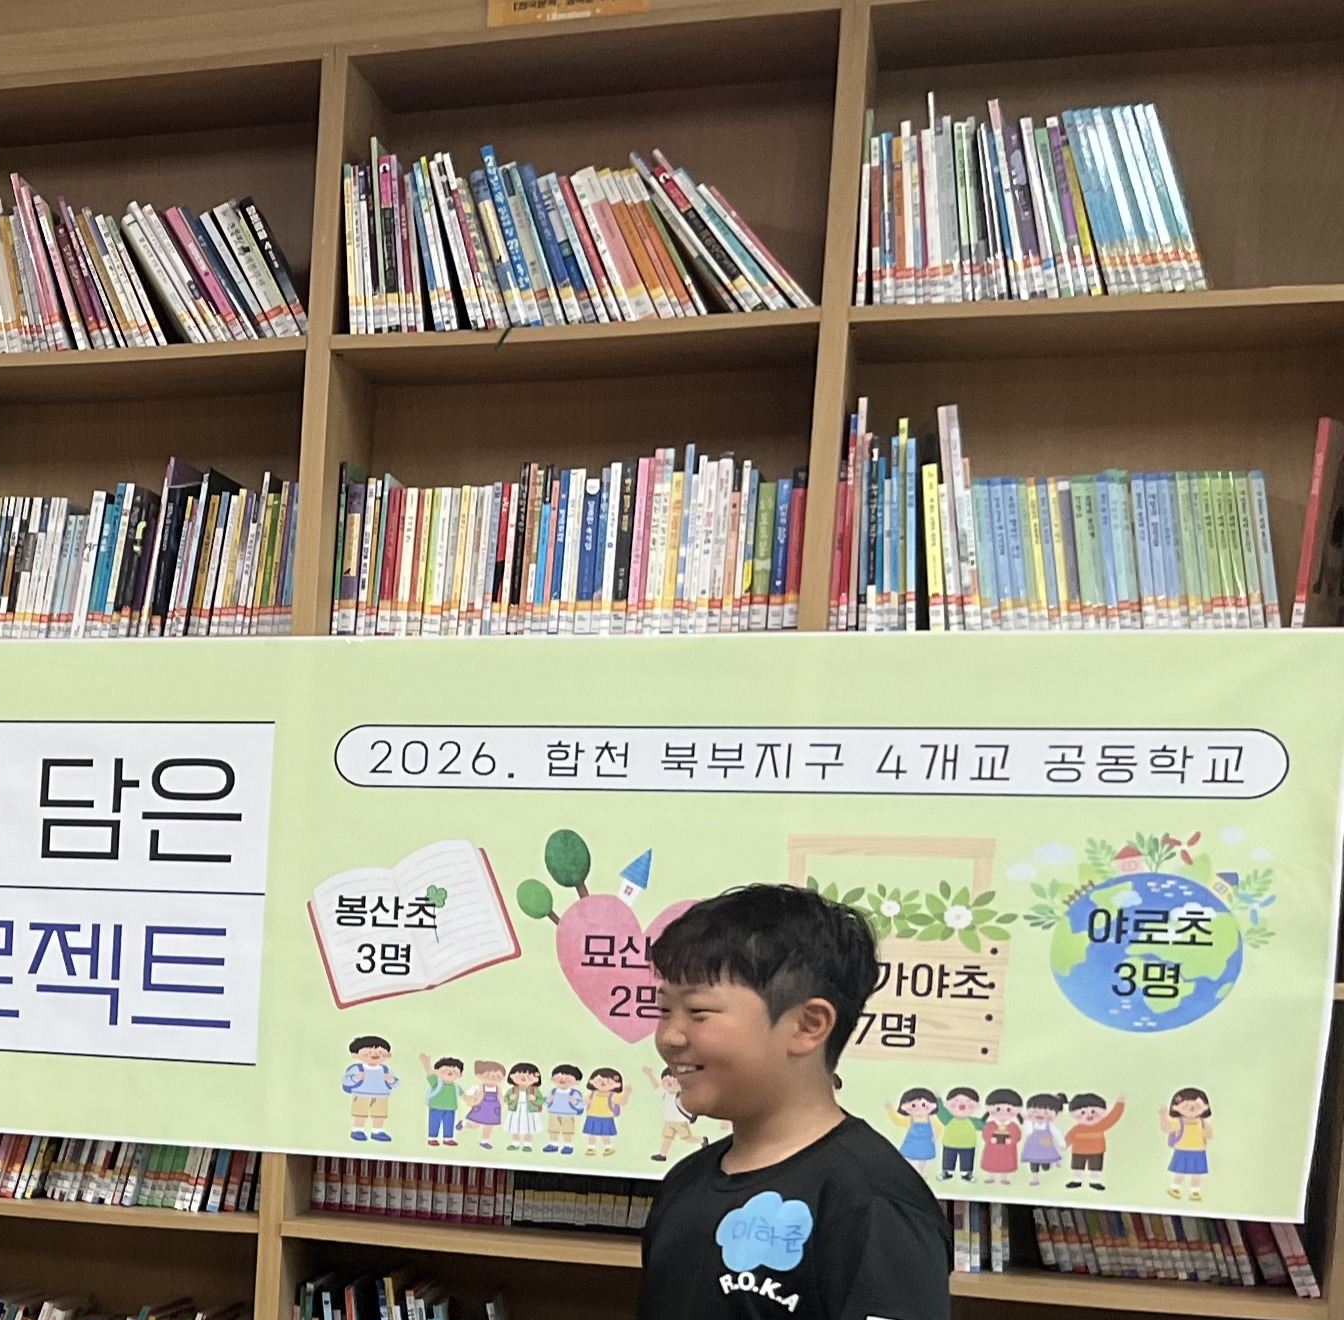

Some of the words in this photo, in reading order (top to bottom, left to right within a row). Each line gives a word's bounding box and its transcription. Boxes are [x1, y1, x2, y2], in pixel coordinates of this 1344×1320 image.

[369, 740, 516, 780] 2026.
[546, 740, 630, 780] 합천
[660, 742, 846, 782] 북부지구
[875, 743, 1012, 784] 4개교
[1043, 744, 1247, 786] 공동학교
[38, 756, 244, 864] 담은
[334, 894, 438, 931] 봉산초
[1086, 906, 1215, 949] 야로초
[354, 942, 412, 977] 3명
[581, 934, 654, 969] 묘산
[1110, 961, 1183, 1001] 3명
[855, 1012, 917, 1047] 7명
[731, 1216, 805, 1254] 이하준
[718, 1271, 800, 1313] R.O.K.A
